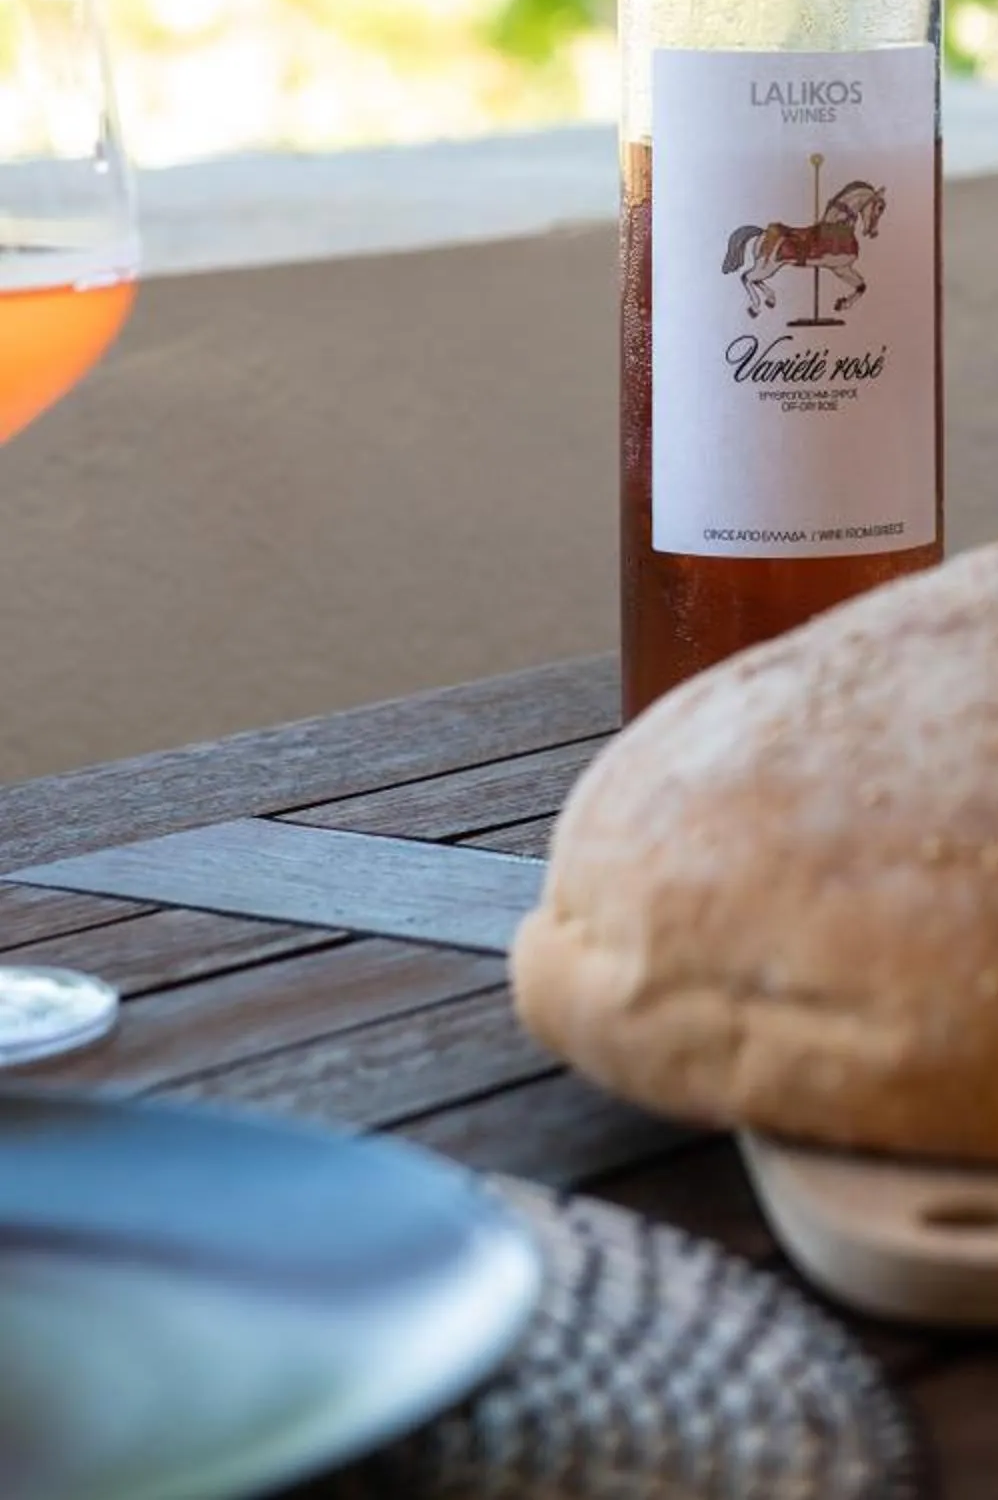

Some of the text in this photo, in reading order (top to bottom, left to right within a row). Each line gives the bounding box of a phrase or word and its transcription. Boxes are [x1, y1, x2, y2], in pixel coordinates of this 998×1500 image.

[751, 80, 863, 106] LALIKOS
[781, 107, 837, 123] WINES
[830, 346, 887, 381] rosé
